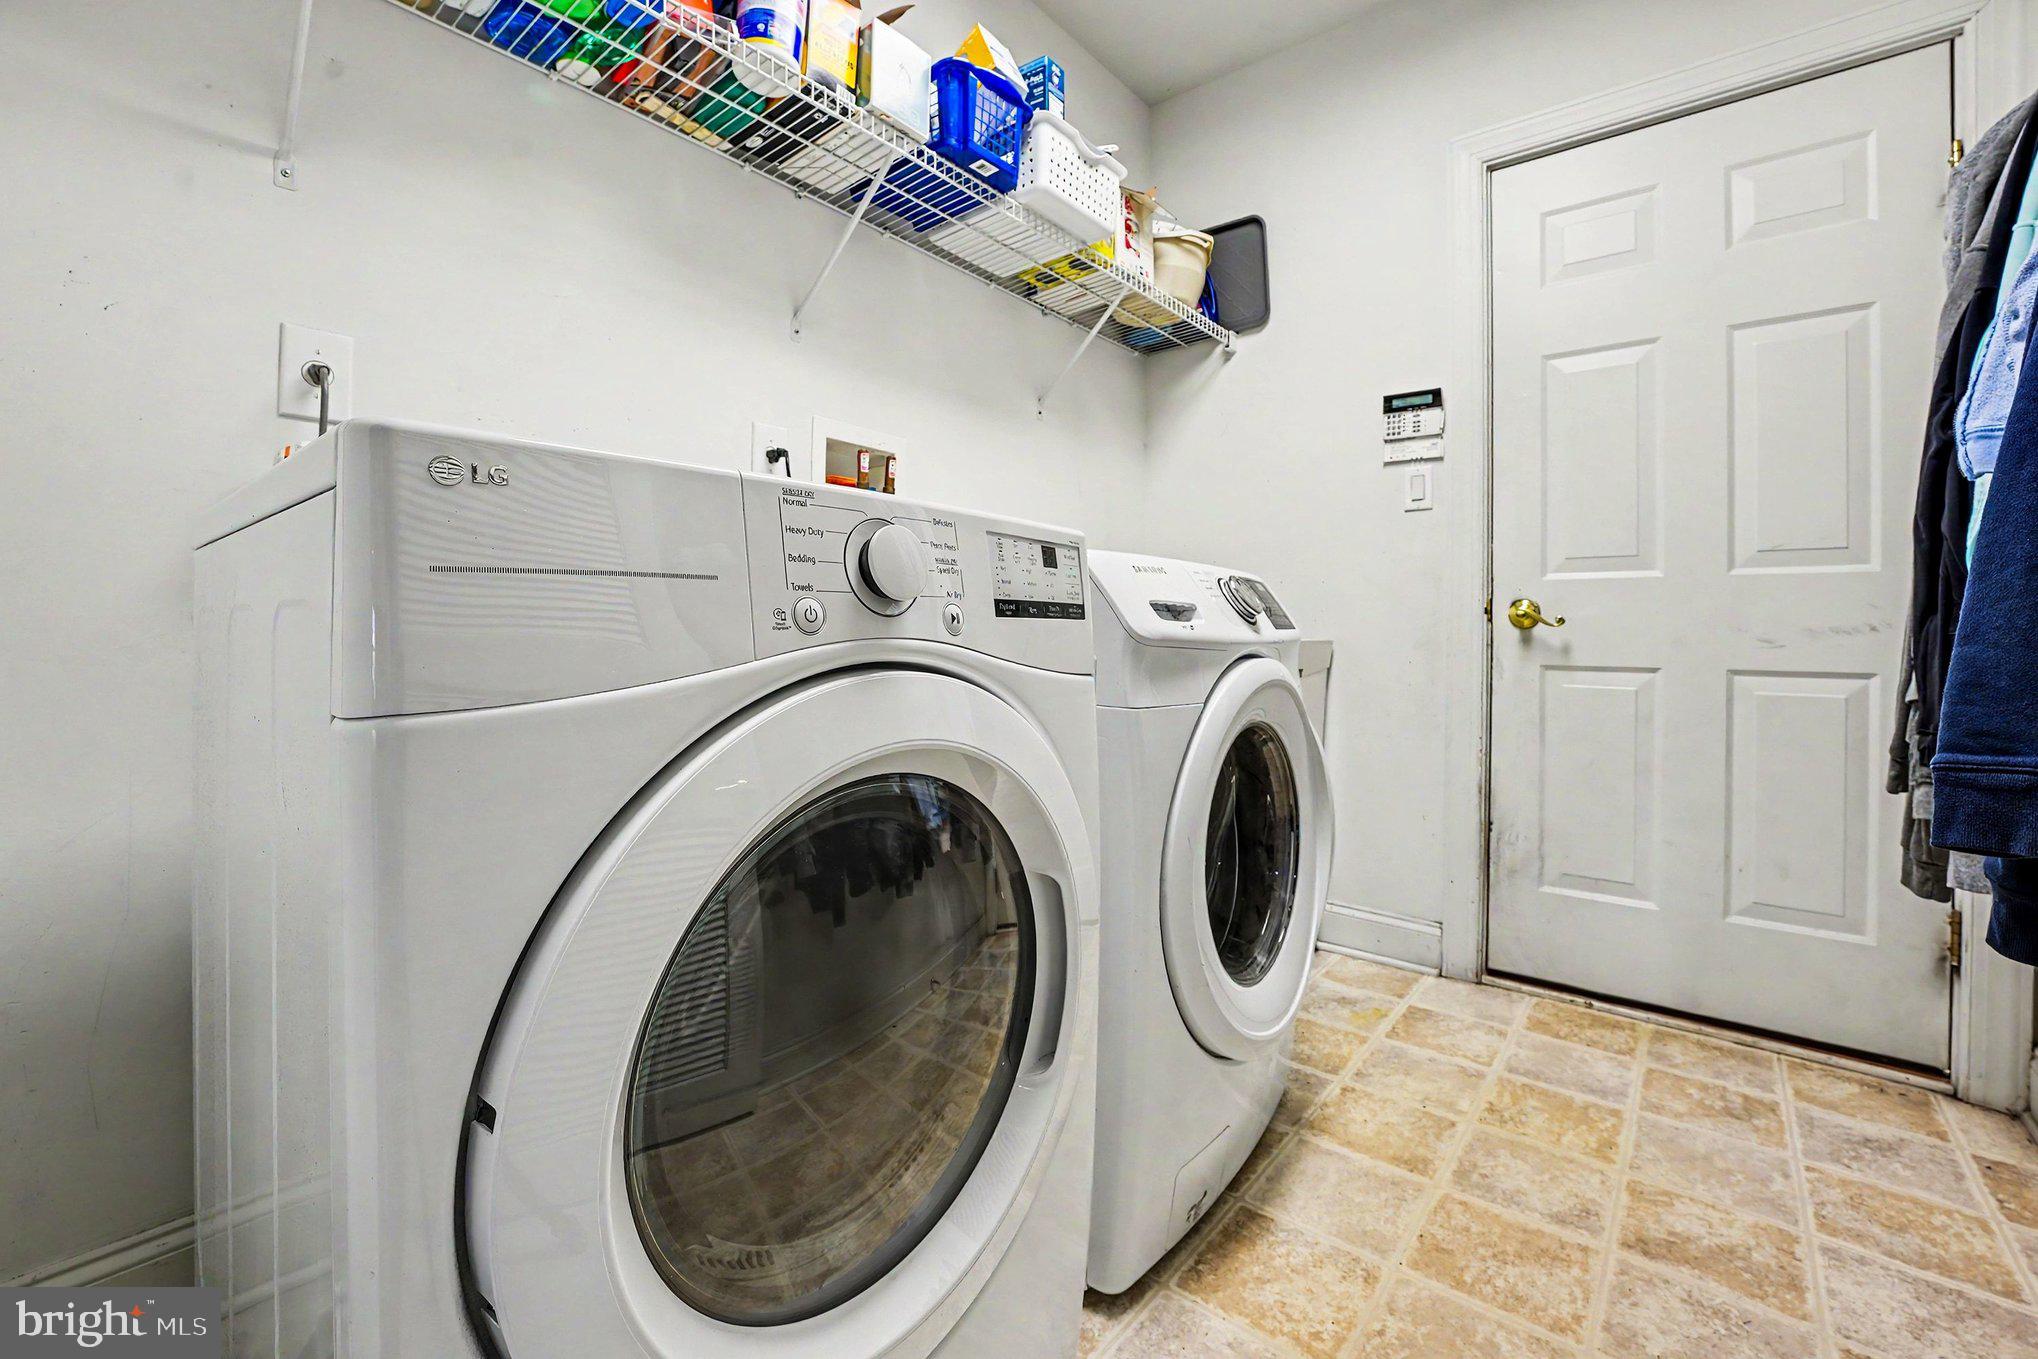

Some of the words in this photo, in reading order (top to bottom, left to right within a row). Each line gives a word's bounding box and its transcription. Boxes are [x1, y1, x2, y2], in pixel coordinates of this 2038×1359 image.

[471, 462, 509, 486] LG
[783, 497, 807, 507] Normal
[785, 525, 806, 537] Heavy
[808, 527, 824, 538] Duty
[788, 553, 816, 566] Bedding
[791, 582, 814, 592] Towels
